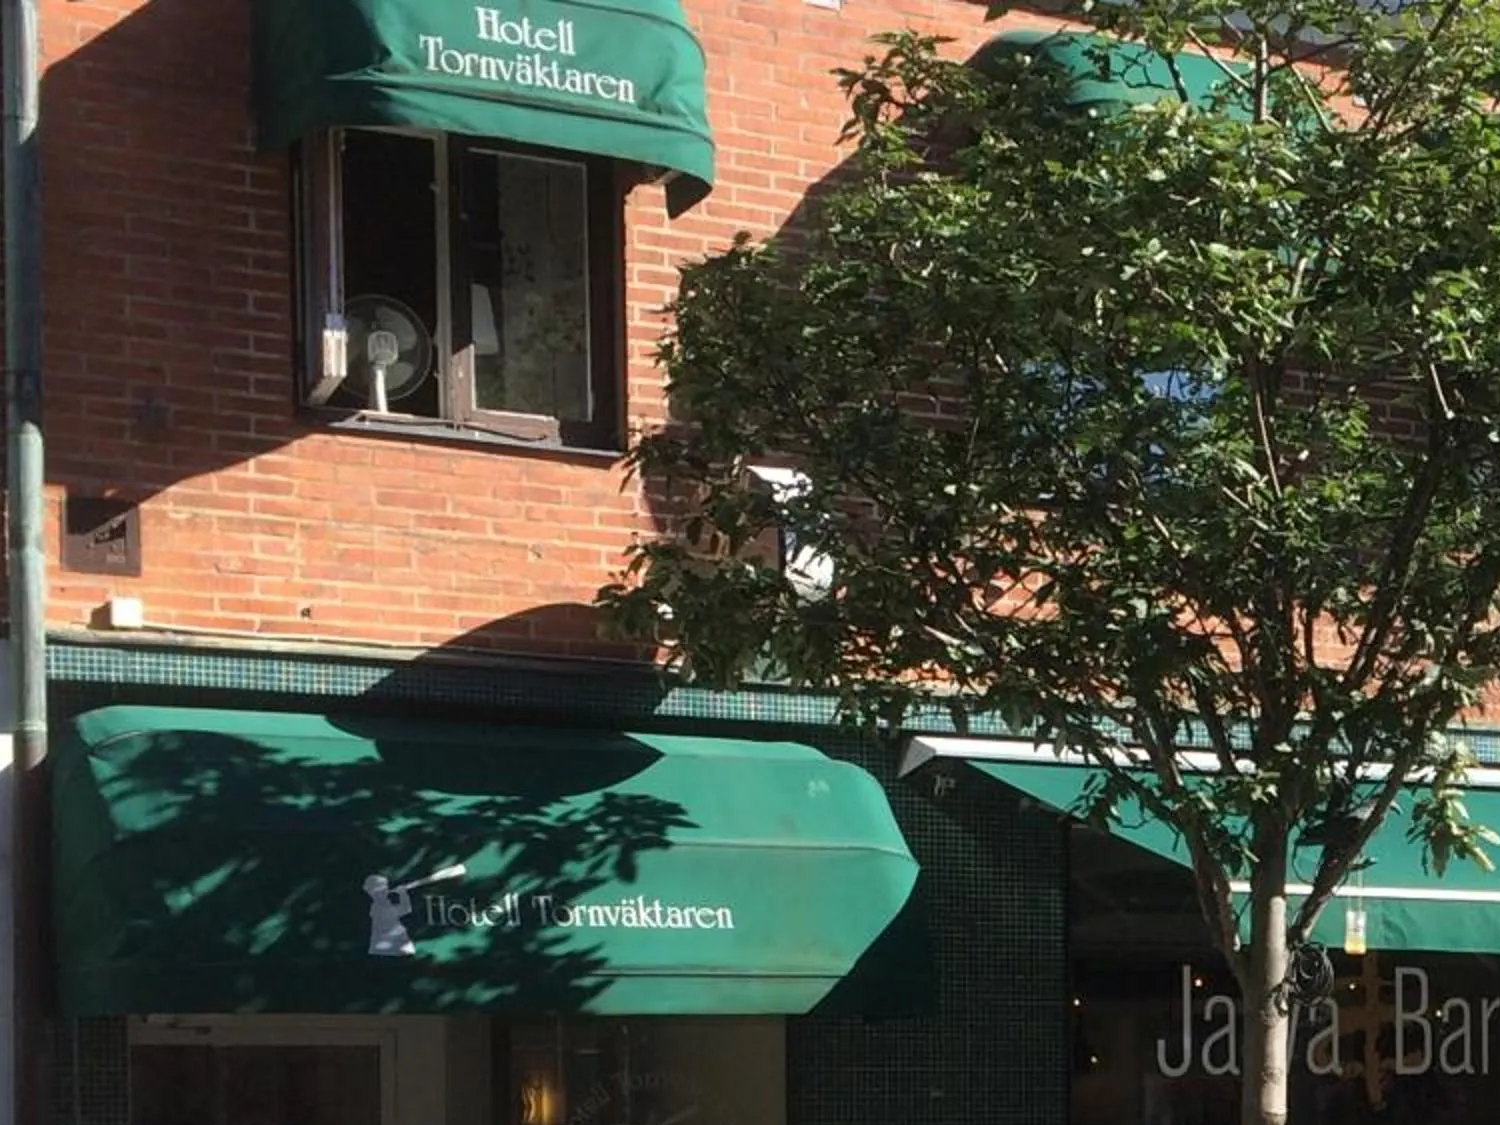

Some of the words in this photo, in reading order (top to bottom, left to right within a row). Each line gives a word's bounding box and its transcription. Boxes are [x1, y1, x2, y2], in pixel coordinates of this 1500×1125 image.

[475, 6, 576, 56] Hotell
[419, 34, 636, 104] Tornväktaren
[424, 893, 520, 928] Hotell
[532, 894, 736, 930] Tornväktaren
[1157, 964, 1343, 1078] Jaa
